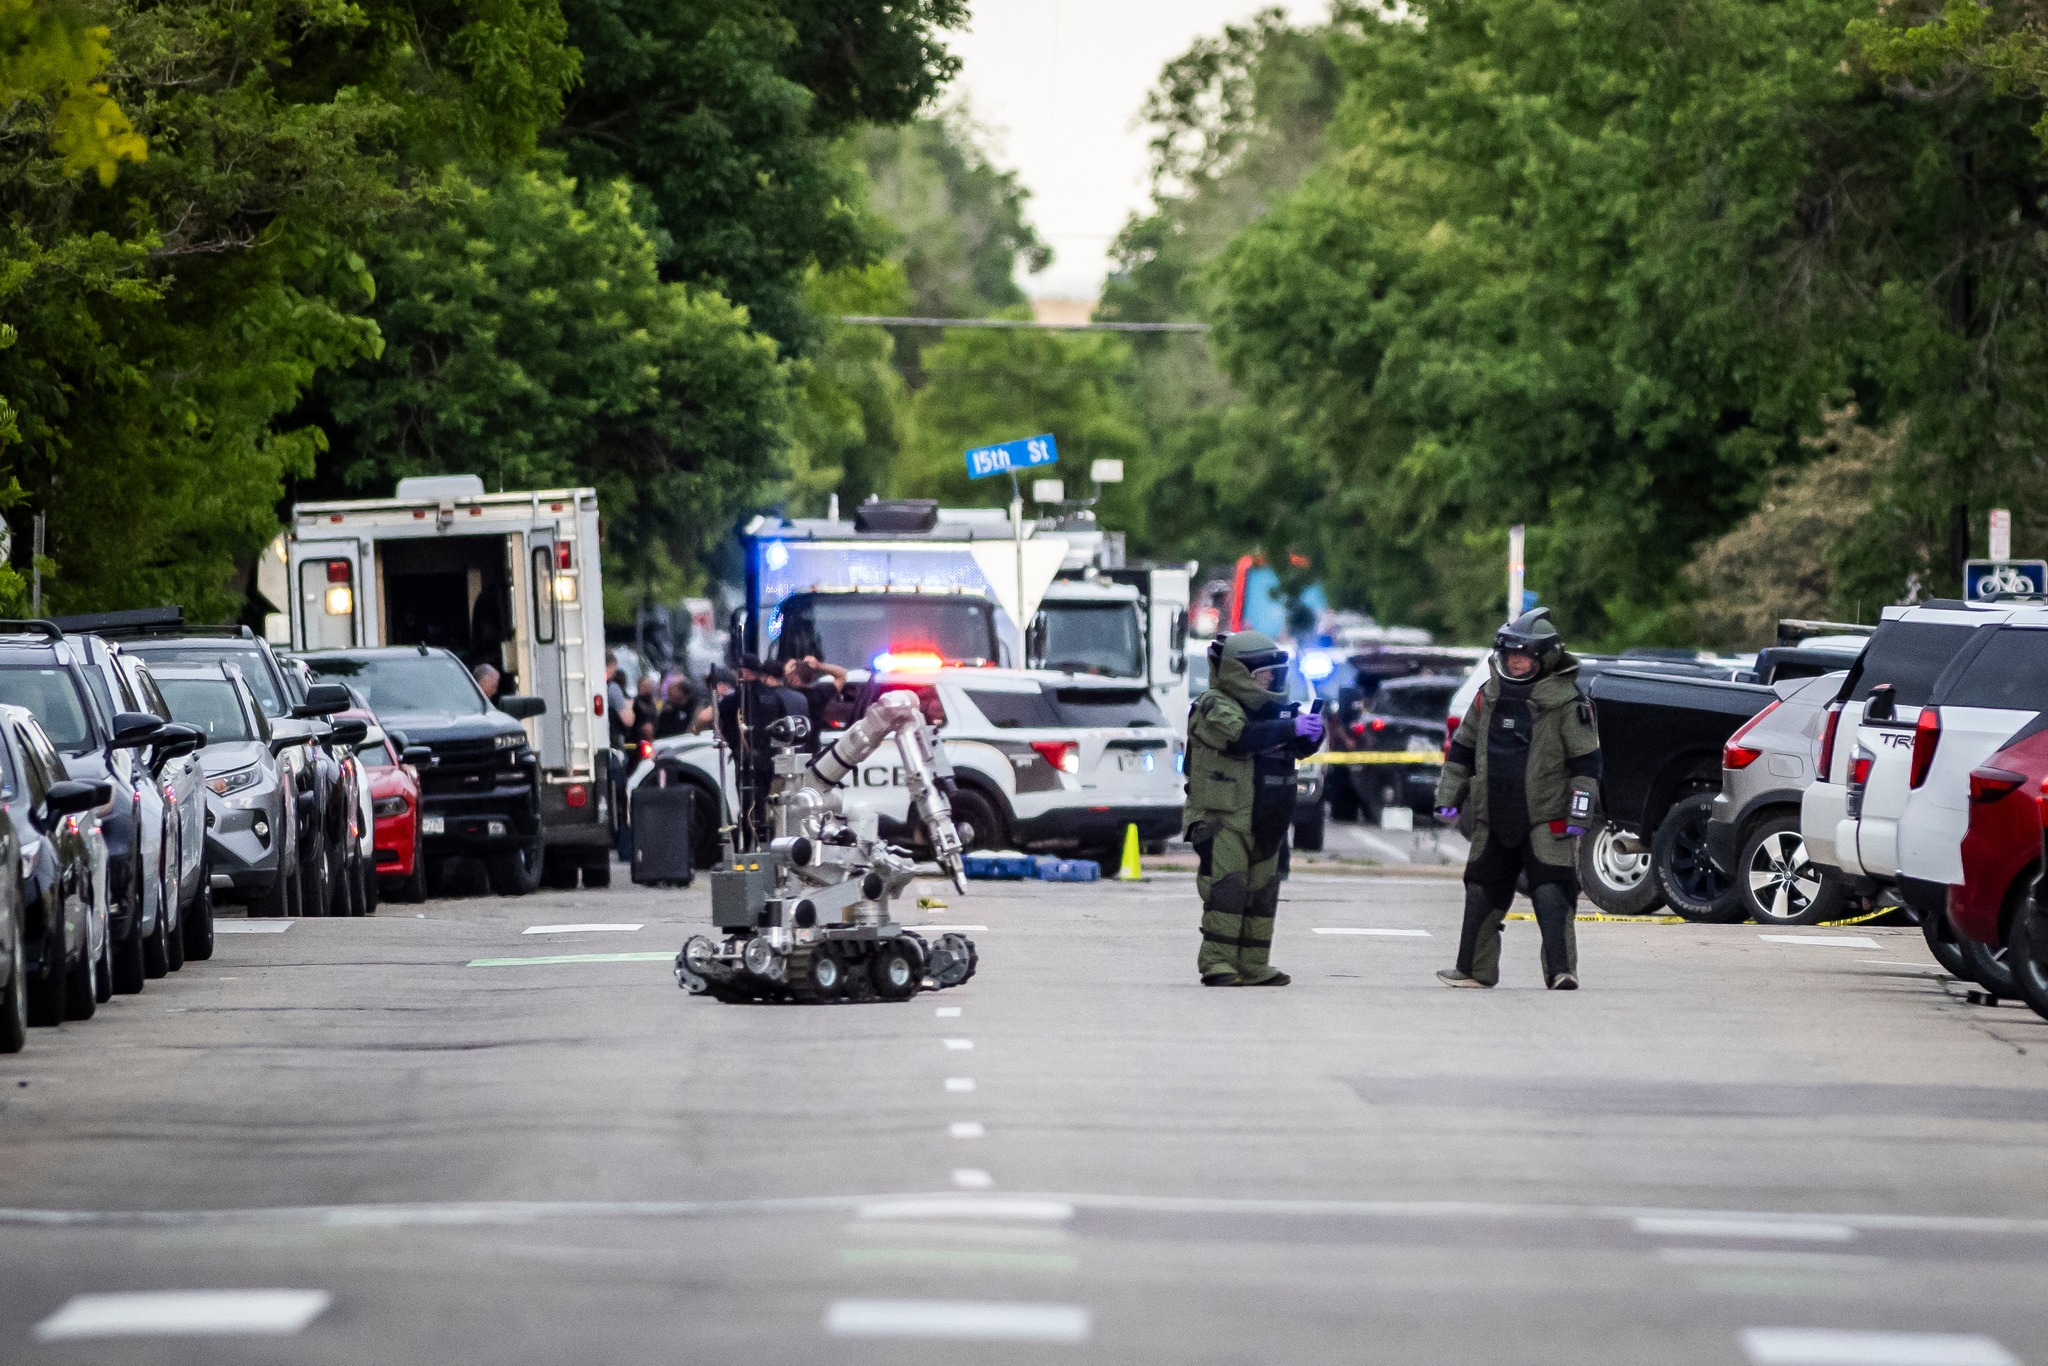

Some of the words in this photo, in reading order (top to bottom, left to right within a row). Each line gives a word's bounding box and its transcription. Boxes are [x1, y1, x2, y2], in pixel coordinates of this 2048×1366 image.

[972, 448, 1011, 474] 15th
[1027, 440, 1050, 463] St
[843, 765, 908, 787] ICE
